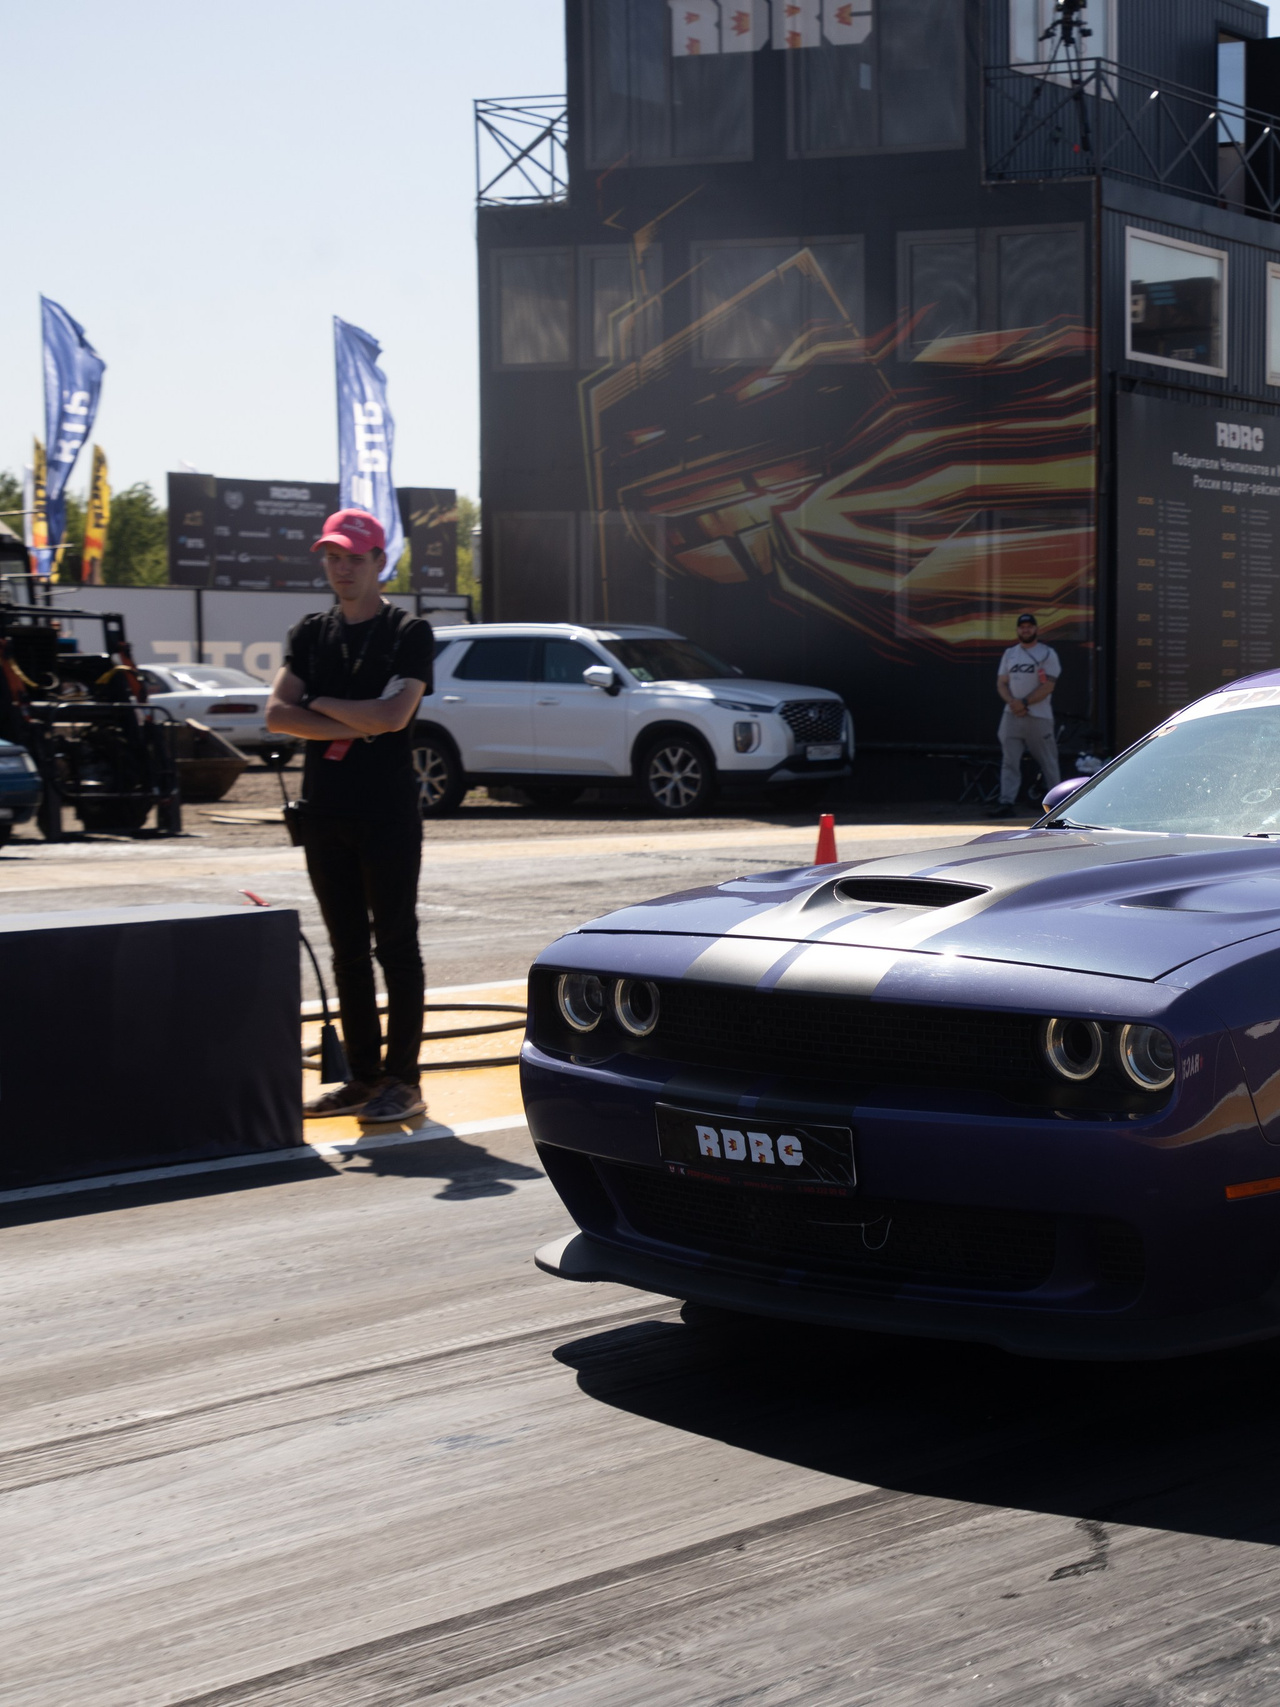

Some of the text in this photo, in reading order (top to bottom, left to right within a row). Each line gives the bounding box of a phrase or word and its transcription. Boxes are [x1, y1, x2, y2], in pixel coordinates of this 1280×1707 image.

[667, 0, 873, 57] RDRC
[353, 400, 388, 473] ВТБ
[1216, 421, 1264, 452] RDRC
[695, 1124, 804, 1167] RDRC
